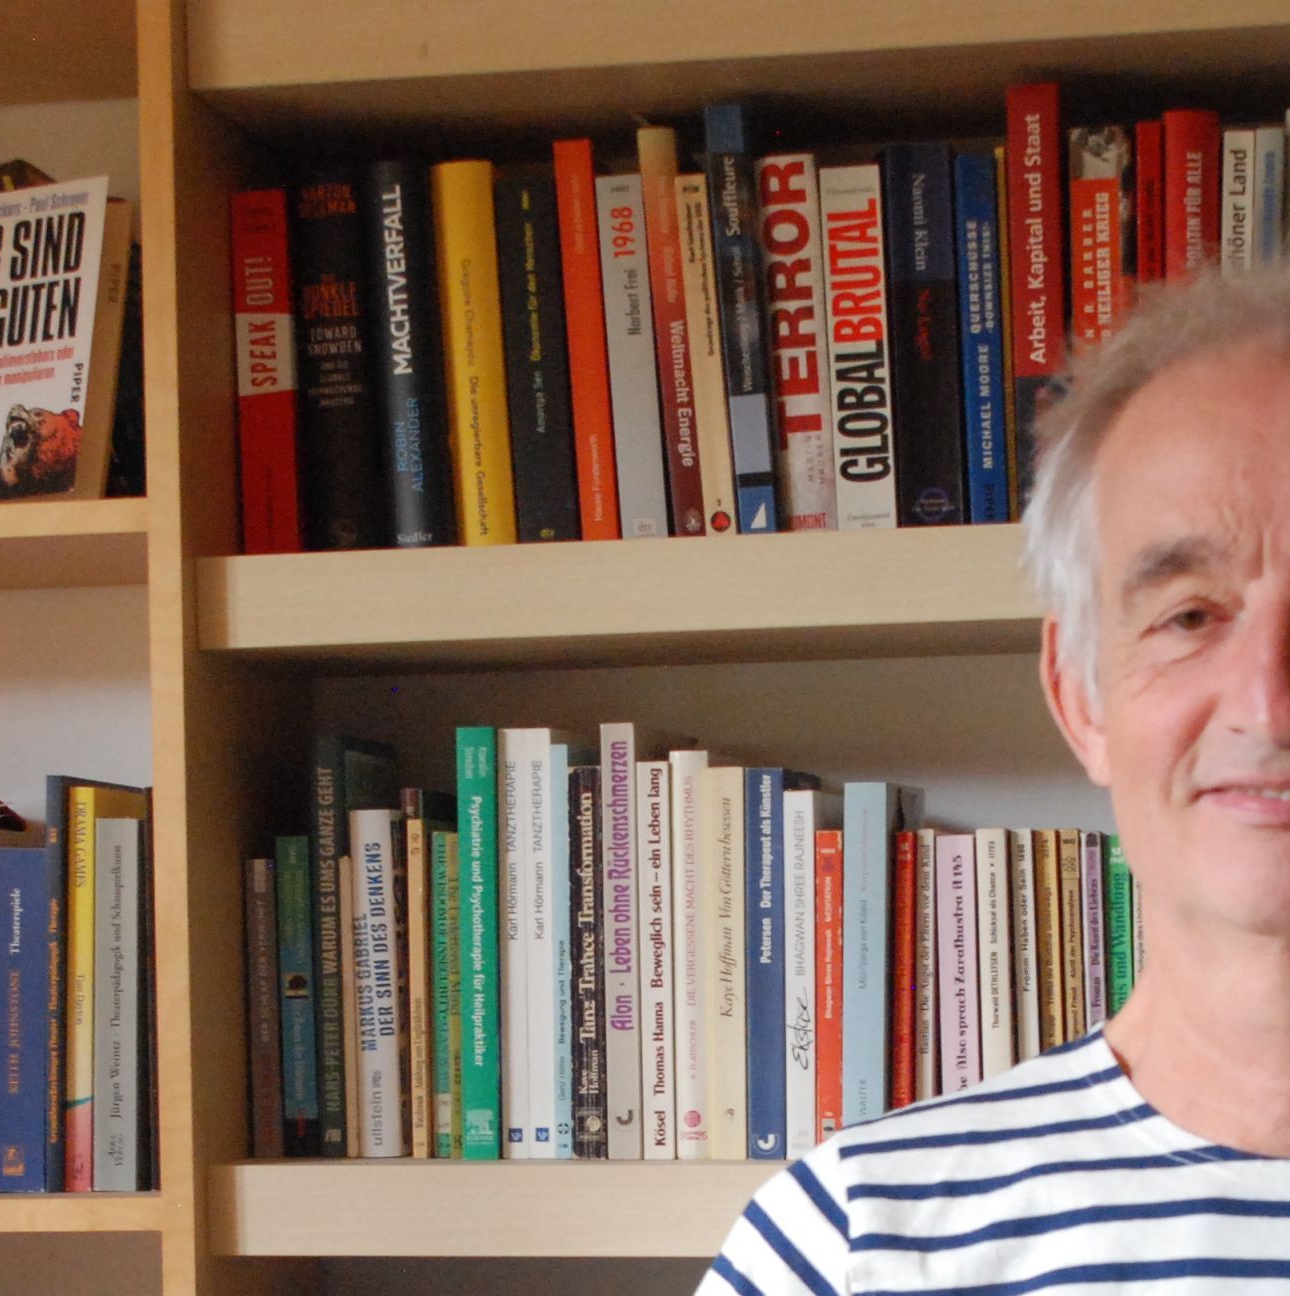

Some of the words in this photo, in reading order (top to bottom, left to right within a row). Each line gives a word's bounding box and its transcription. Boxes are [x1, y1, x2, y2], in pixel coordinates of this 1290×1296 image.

[1024, 114, 1042, 166] Staat
[1027, 171, 1042, 212] und
[1186, 152, 1201, 184] ALLE
[1229, 148, 1247, 195] Land
[720, 156, 741, 237] Souffleure
[1096, 192, 1109, 243] KRIEG
[1184, 188, 1201, 213] FÜR
[10, 212, 86, 281] SIND
[611, 206, 636, 259] 1968
[1027, 218, 1047, 288] Kapital
[1186, 218, 1202, 268] POLITIK
[1227, 203, 1249, 269] chöner
[245, 255, 275, 306] OUT!
[382, 184, 413, 375] MACHTVERFALL
[623, 268, 639, 290] Frei
[965, 219, 981, 335] QUERSCHÜSSE
[1097, 248, 1111, 324] HEILIGER
[626, 293, 643, 336] Norbert
[759, 158, 823, 451] TERROR
[1030, 295, 1047, 364] Arbeit,
[247, 318, 279, 387] SPEAK
[668, 319, 692, 403] Weltmacht
[977, 344, 989, 396] MOORE
[71, 362, 84, 403] PIPER
[395, 421, 408, 472] ROBIN
[406, 397, 423, 491] ALEXANDER
[677, 407, 696, 467] Energie
[979, 402, 994, 469] MICHAEL
[317, 768, 333, 805] GEHT
[505, 760, 517, 853] TANZTHERAPIE
[531, 760, 543, 853] TANZTHERAPIE
[647, 768, 662, 798] lang
[758, 774, 771, 817] Künstler
[318, 810, 334, 856] GANZE
[469, 796, 484, 858] Psychiatrie
[607, 741, 630, 879] Rückenschmerzen
[648, 803, 661, 844] Leben
[759, 819, 771, 834] als
[578, 792, 595, 927] Transformation
[649, 848, 661, 869] ein
[759, 836, 773, 888] Therapeut
[793, 811, 805, 870] RAJNEESH
[111, 845, 123, 919] Schauspielkunst
[320, 860, 335, 892] UMS
[366, 843, 386, 917] DENKENS
[472, 861, 482, 882] und
[506, 862, 517, 914] Hörmann
[533, 862, 544, 913] Hörmann
[793, 874, 805, 908] SHREE
[10, 887, 23, 955] Theaterspiele
[321, 896, 335, 912] ES
[608, 885, 629, 923] ohne
[649, 885, 662, 913] sein
[760, 889, 771, 908] Der
[1110, 873, 1128, 947] Wandlung
[111, 923, 122, 941] und
[322, 917, 338, 974] WARUM
[354, 913, 371, 979] GABRIEL
[372, 923, 388, 952] DES
[469, 885, 484, 970] Psychotherapie
[507, 917, 517, 940] Karl
[534, 916, 544, 940] Karl
[609, 927, 631, 974] Leben
[649, 918, 665, 988] Beweglich
[760, 918, 773, 964] Petersen
[794, 912, 805, 976] BHAGWAN
[953, 896, 965, 985] Zarathustra
[111, 944, 124, 1028] Theaterpädagogik
[375, 960, 392, 999] SINN
[473, 974, 484, 991] für
[579, 932, 595, 994] Trance
[1113, 949, 1127, 980] und
[323, 978, 338, 1018] DÜRR
[358, 984, 376, 1051] MARKUS
[378, 1007, 394, 1036] DER
[580, 1001, 596, 1043] Tanz
[610, 995, 633, 1030] Alon
[652, 1002, 664, 1041] Hanna
[955, 987, 968, 1037] sprach
[471, 994, 486, 1066] Heilpraktiker
[109, 1040, 121, 1078] Weintz
[325, 1023, 340, 1111] HANS-PETER
[653, 1045, 665, 1095] Thomas
[109, 1082, 123, 1118] Jürgen
[371, 1092, 383, 1146] ullstein
[653, 1110, 666, 1146] Kösel
